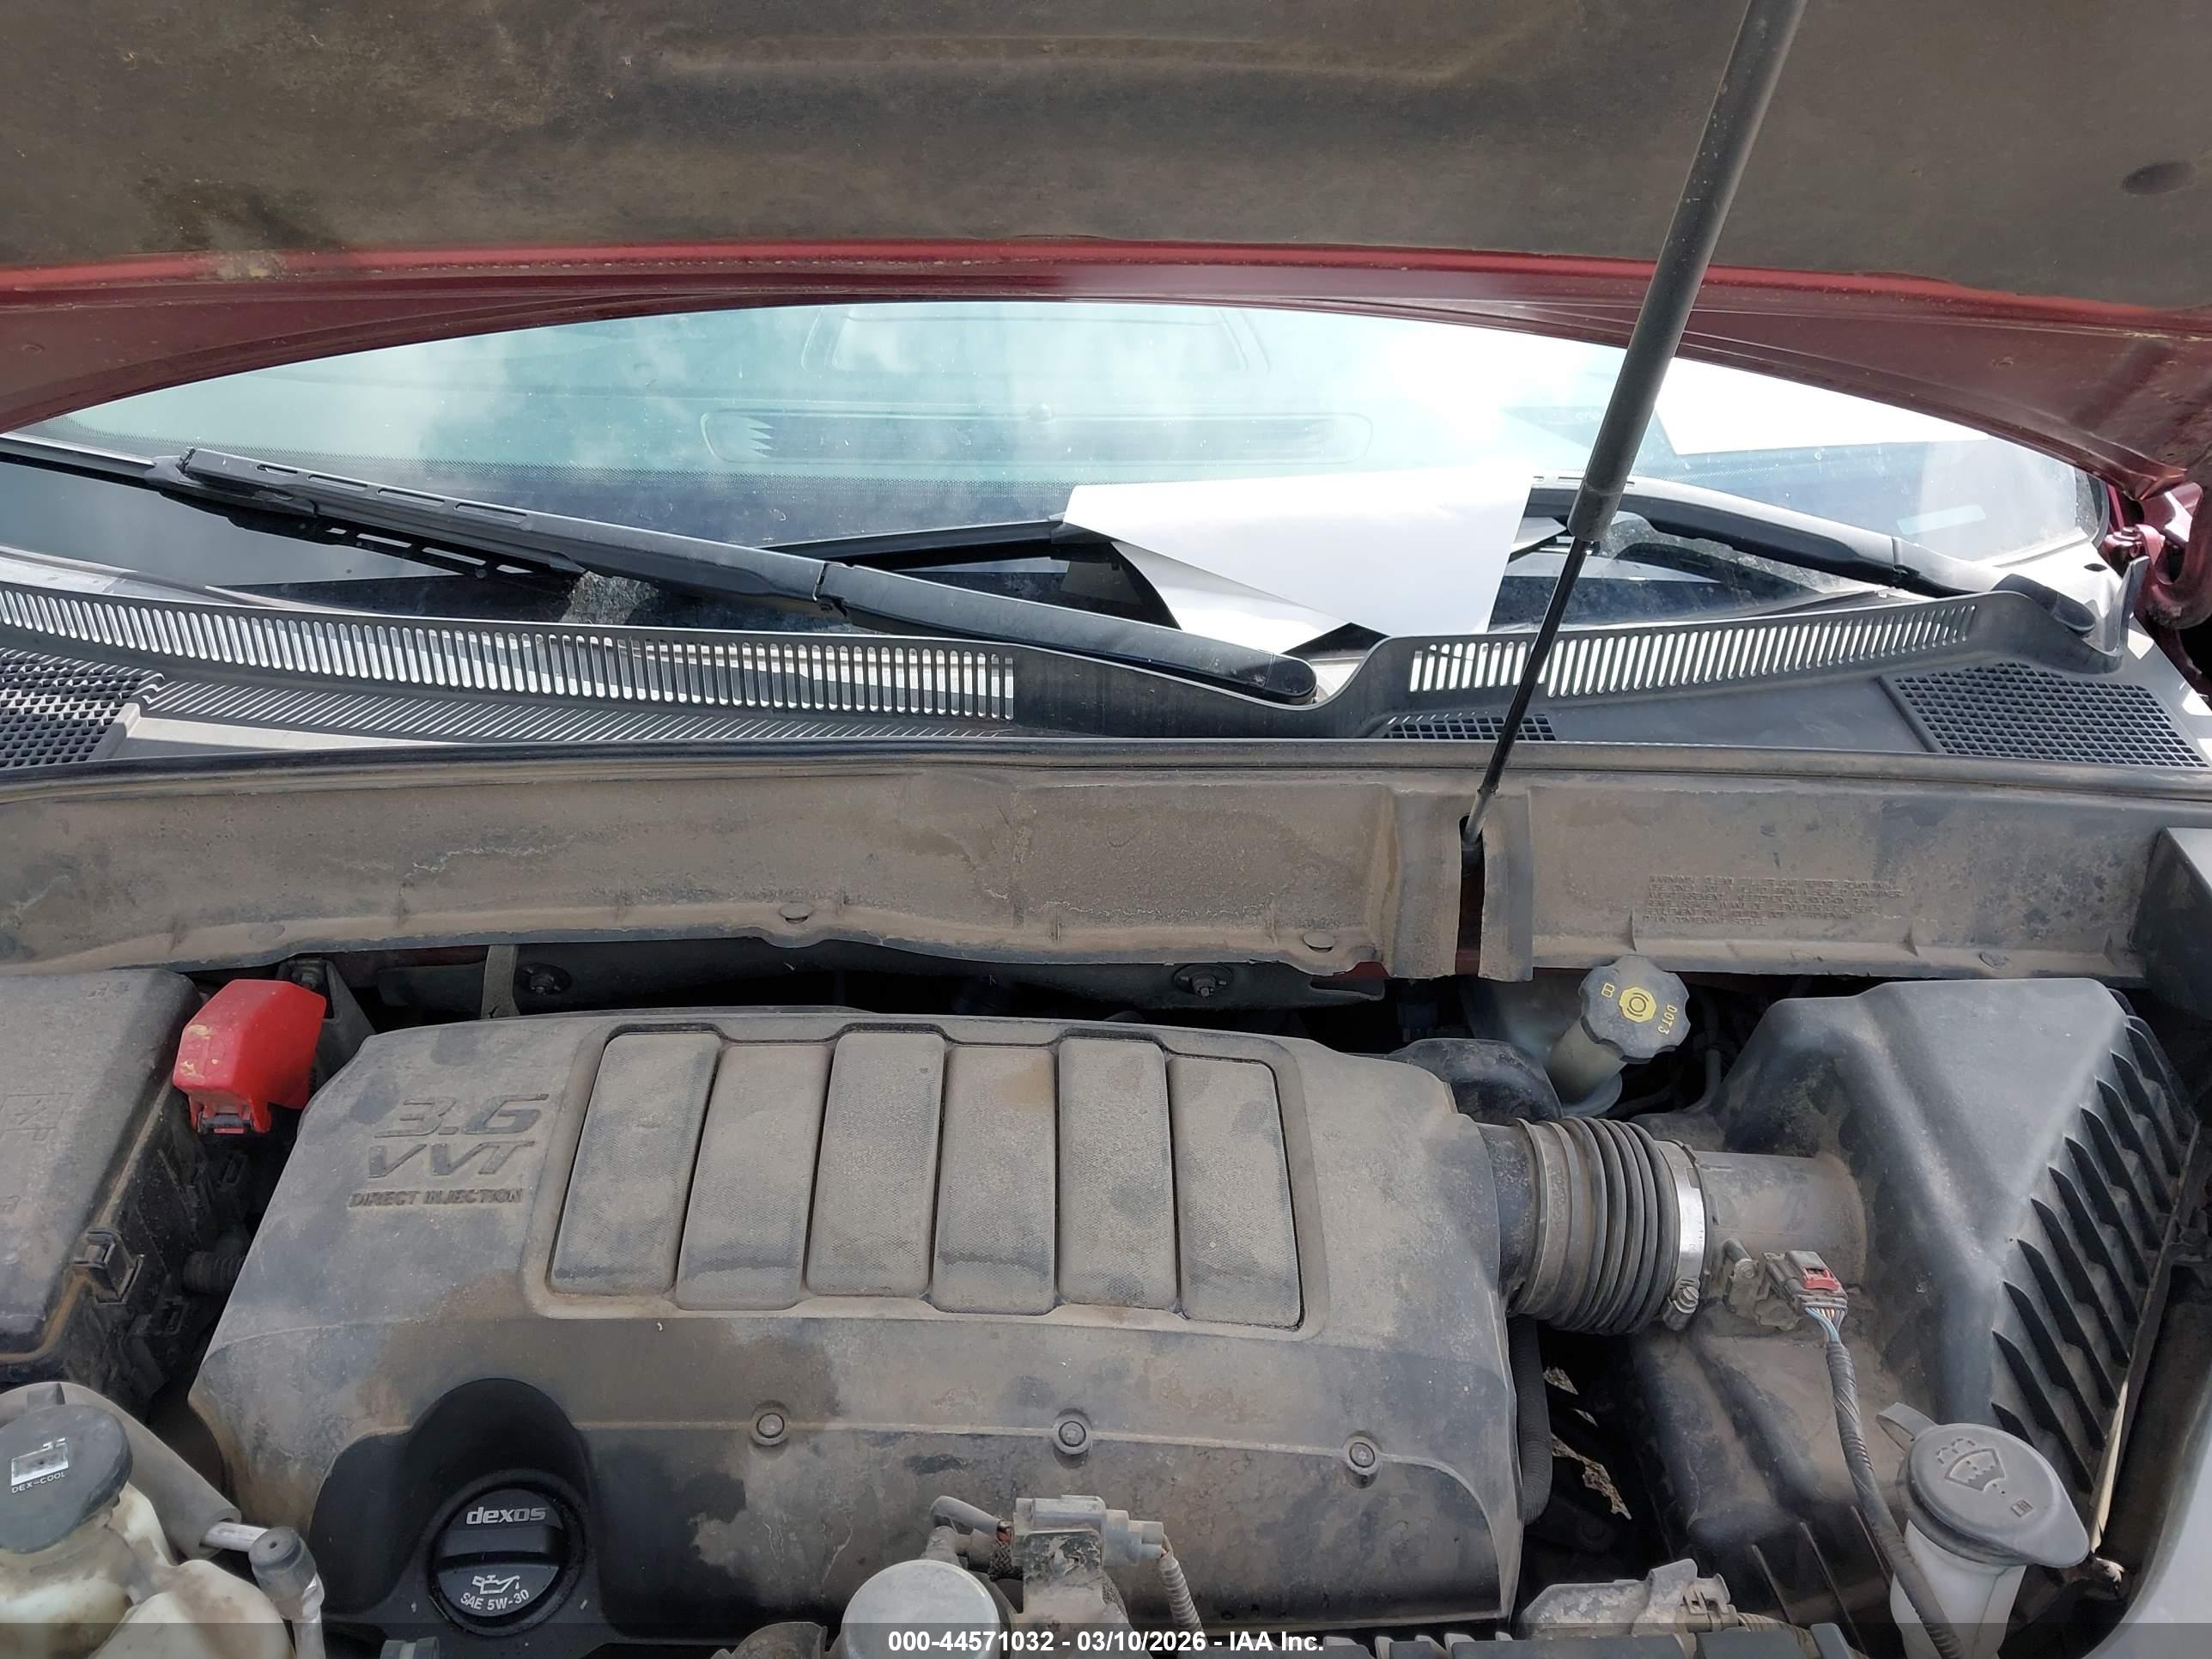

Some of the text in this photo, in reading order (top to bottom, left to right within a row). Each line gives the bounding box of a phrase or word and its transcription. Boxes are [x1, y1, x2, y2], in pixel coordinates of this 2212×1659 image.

[1662, 1004, 1677, 1027] DOT
[374, 1094, 550, 1139] 3.6
[368, 1141, 536, 1178] VVT
[348, 1188, 523, 1207] DIRECT INJECTION
[11, 1471, 66, 1493] DEX-COOL
[465, 1506, 550, 1525] dexos
[459, 1589, 530, 1611] SAE 5W-30
